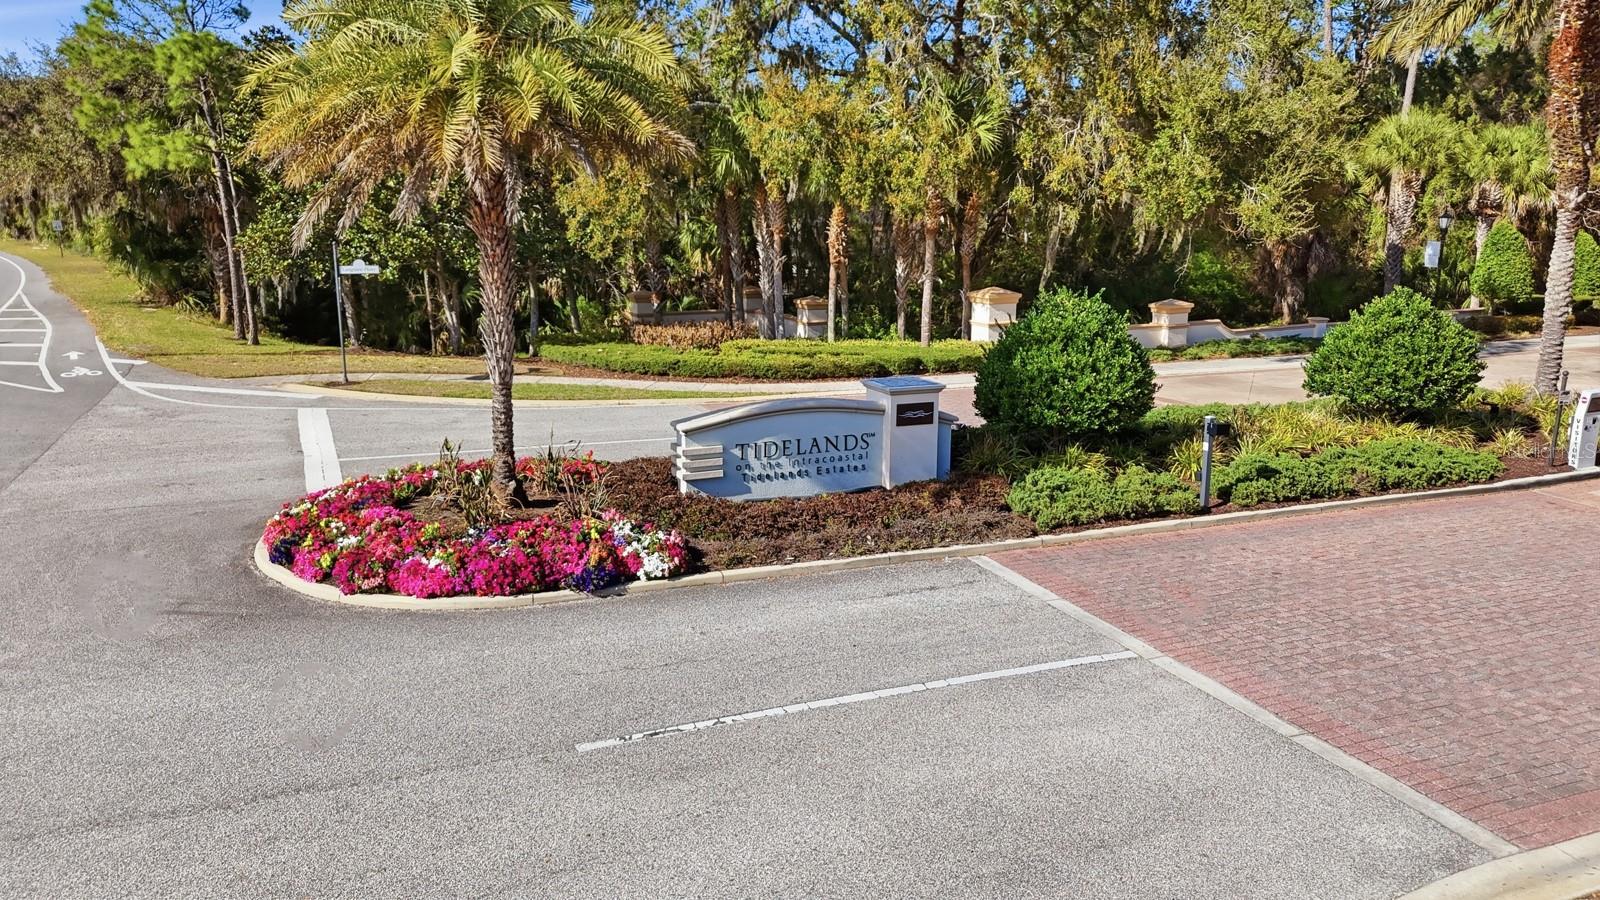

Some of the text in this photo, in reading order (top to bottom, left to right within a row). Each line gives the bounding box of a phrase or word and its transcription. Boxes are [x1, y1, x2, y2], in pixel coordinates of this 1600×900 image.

[1571, 419, 1581, 465] VISITORS
[735, 463, 751, 472] on
[742, 464, 866, 482] Tidelands Estates
